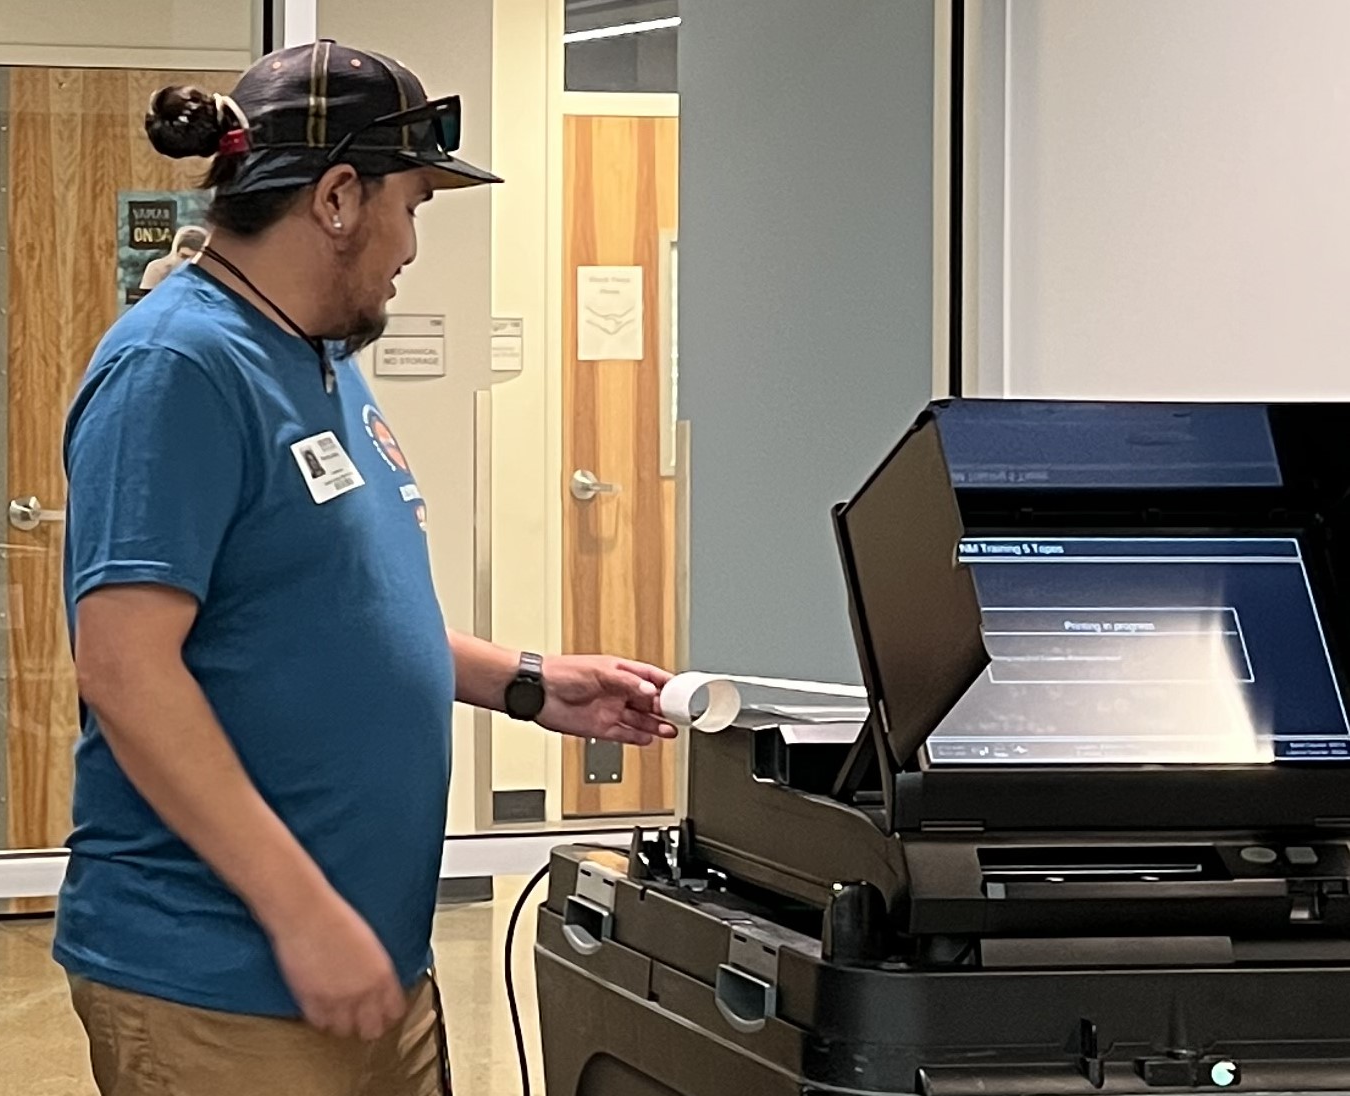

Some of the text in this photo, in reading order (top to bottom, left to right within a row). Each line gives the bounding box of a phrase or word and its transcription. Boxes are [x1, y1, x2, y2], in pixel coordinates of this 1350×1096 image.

[384, 348, 438, 356] MECHANICAL
[383, 357, 439, 366] NO STORAGE
[980, 543, 1022, 556] Training
[1063, 621, 1101, 633] Printing
[1113, 621, 1156, 634] progress
